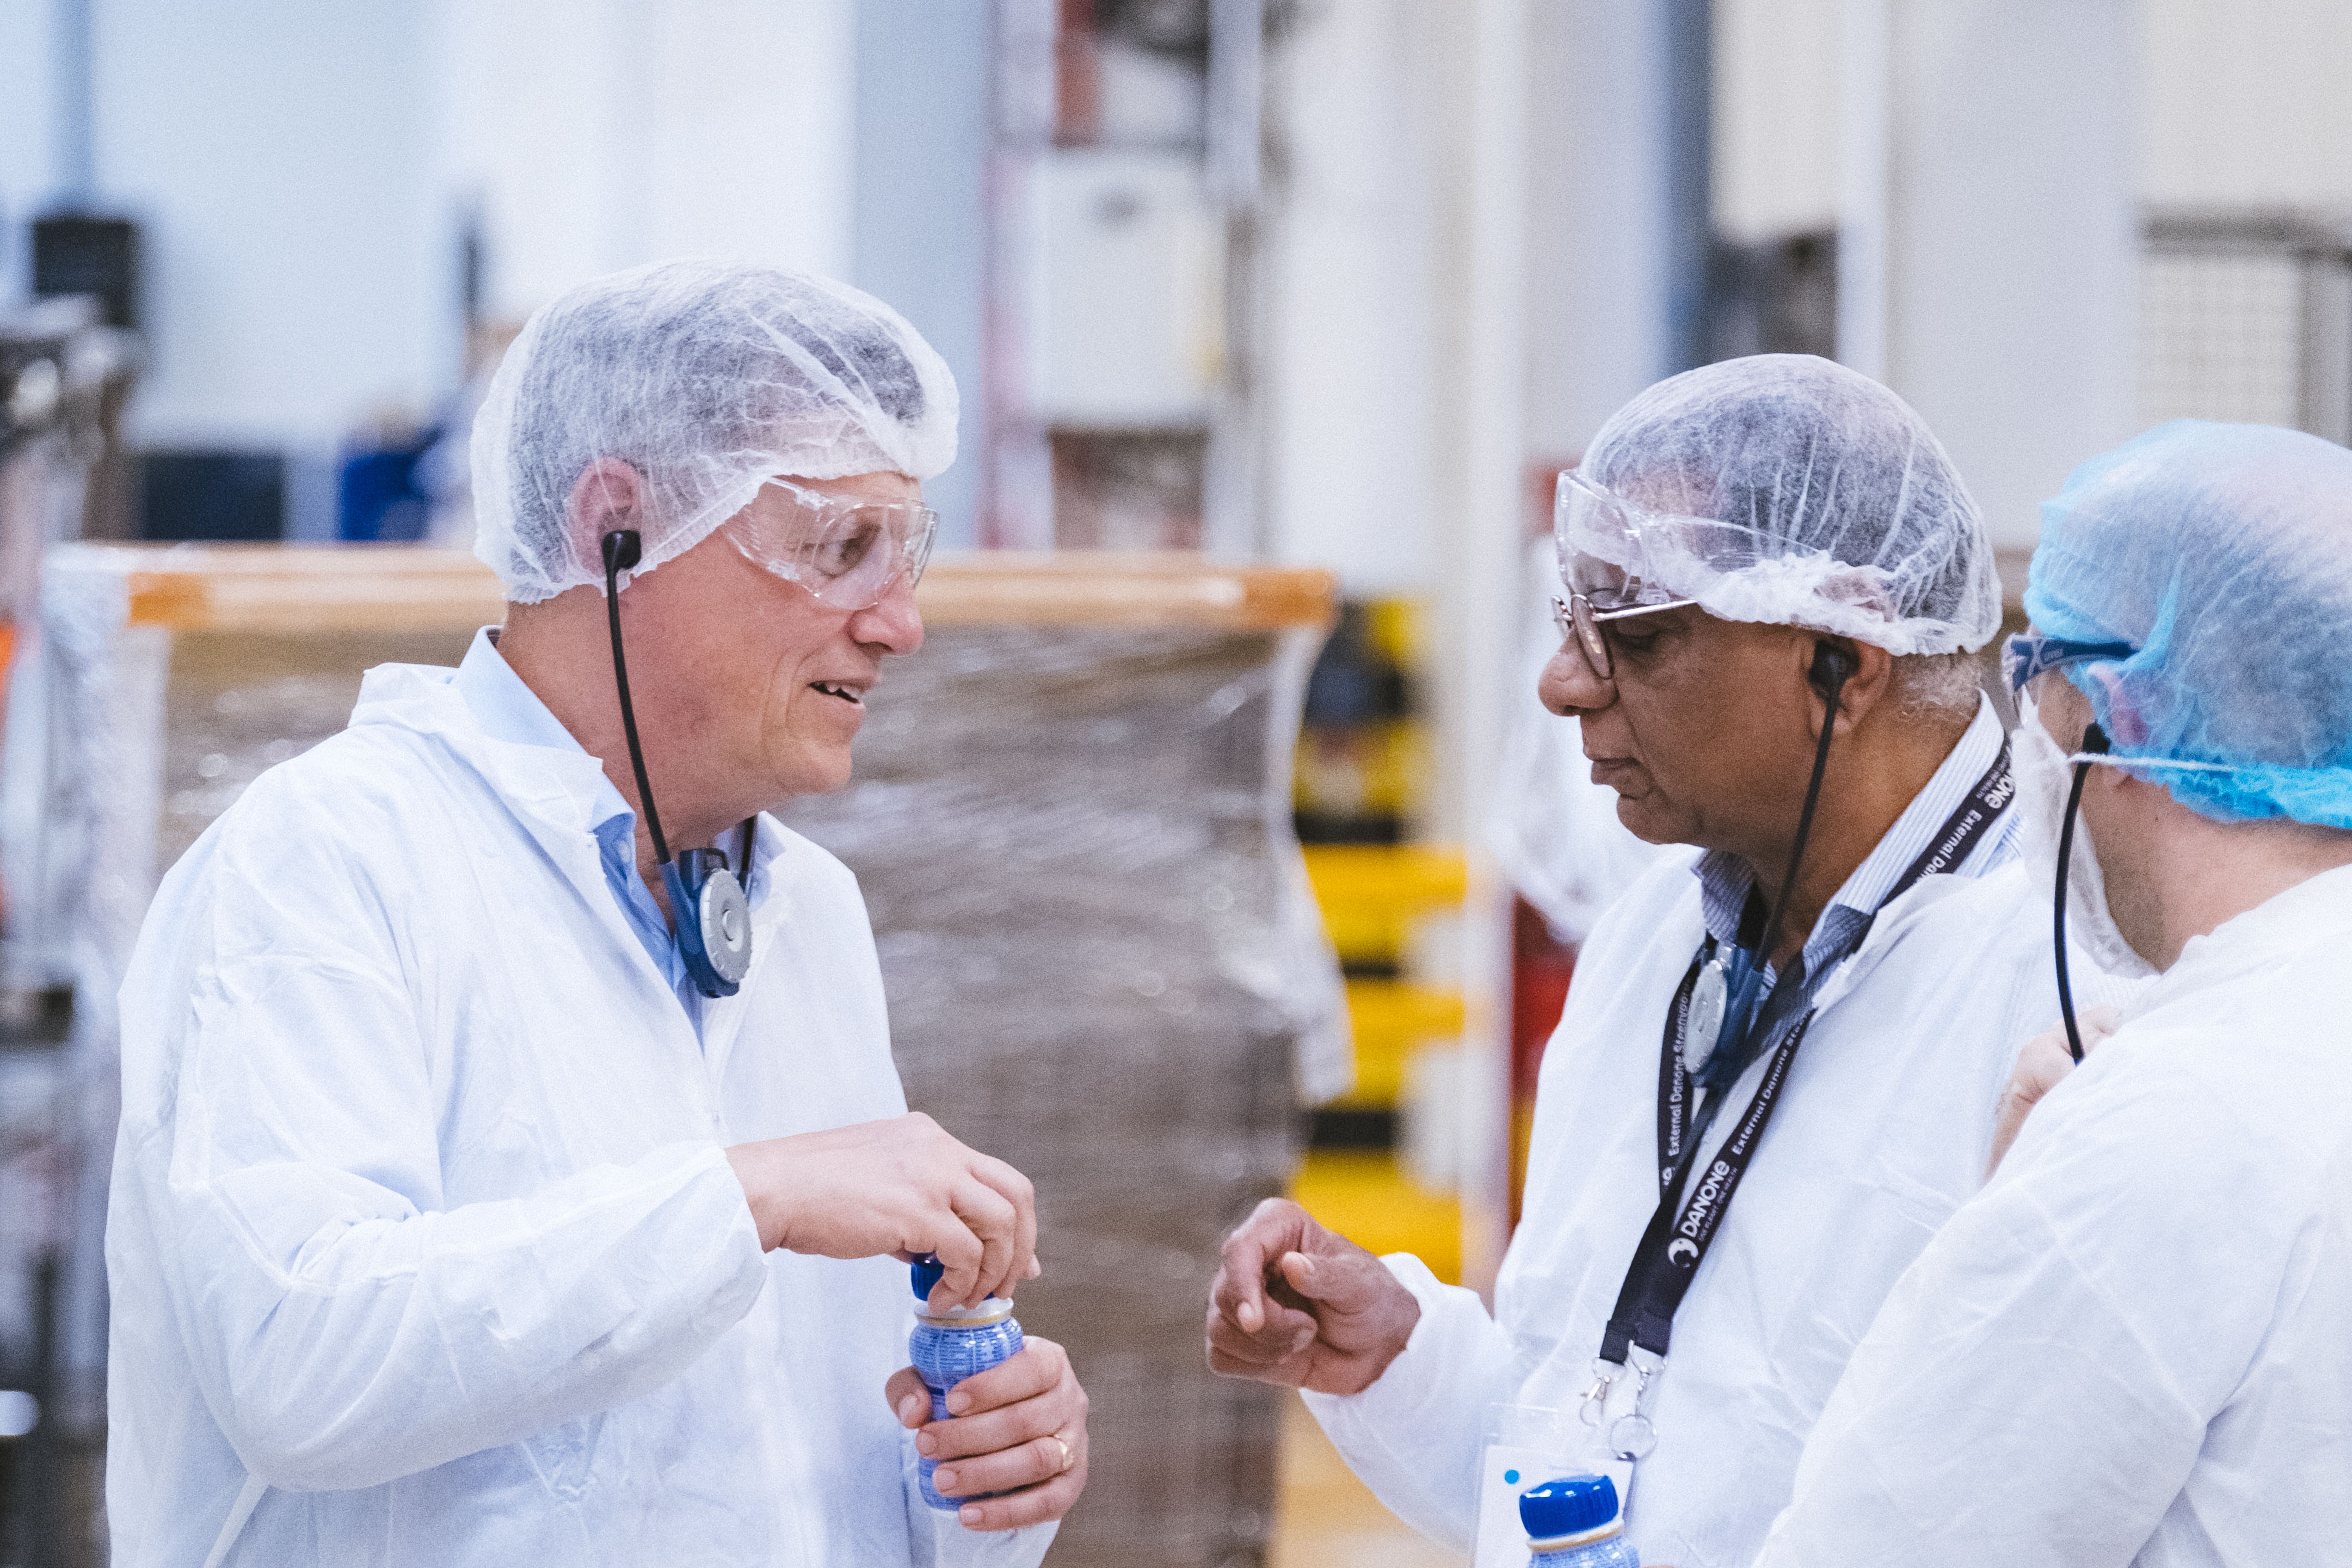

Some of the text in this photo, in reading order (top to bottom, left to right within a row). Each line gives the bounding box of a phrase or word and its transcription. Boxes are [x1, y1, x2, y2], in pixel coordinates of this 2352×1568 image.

[1920, 810, 1983, 878] External Dan
[1669, 1055, 1684, 1103] Danone
[1731, 1101, 1767, 1155] External
[1762, 1048, 1789, 1099] Danone
[1668, 1104, 1682, 1156] External
